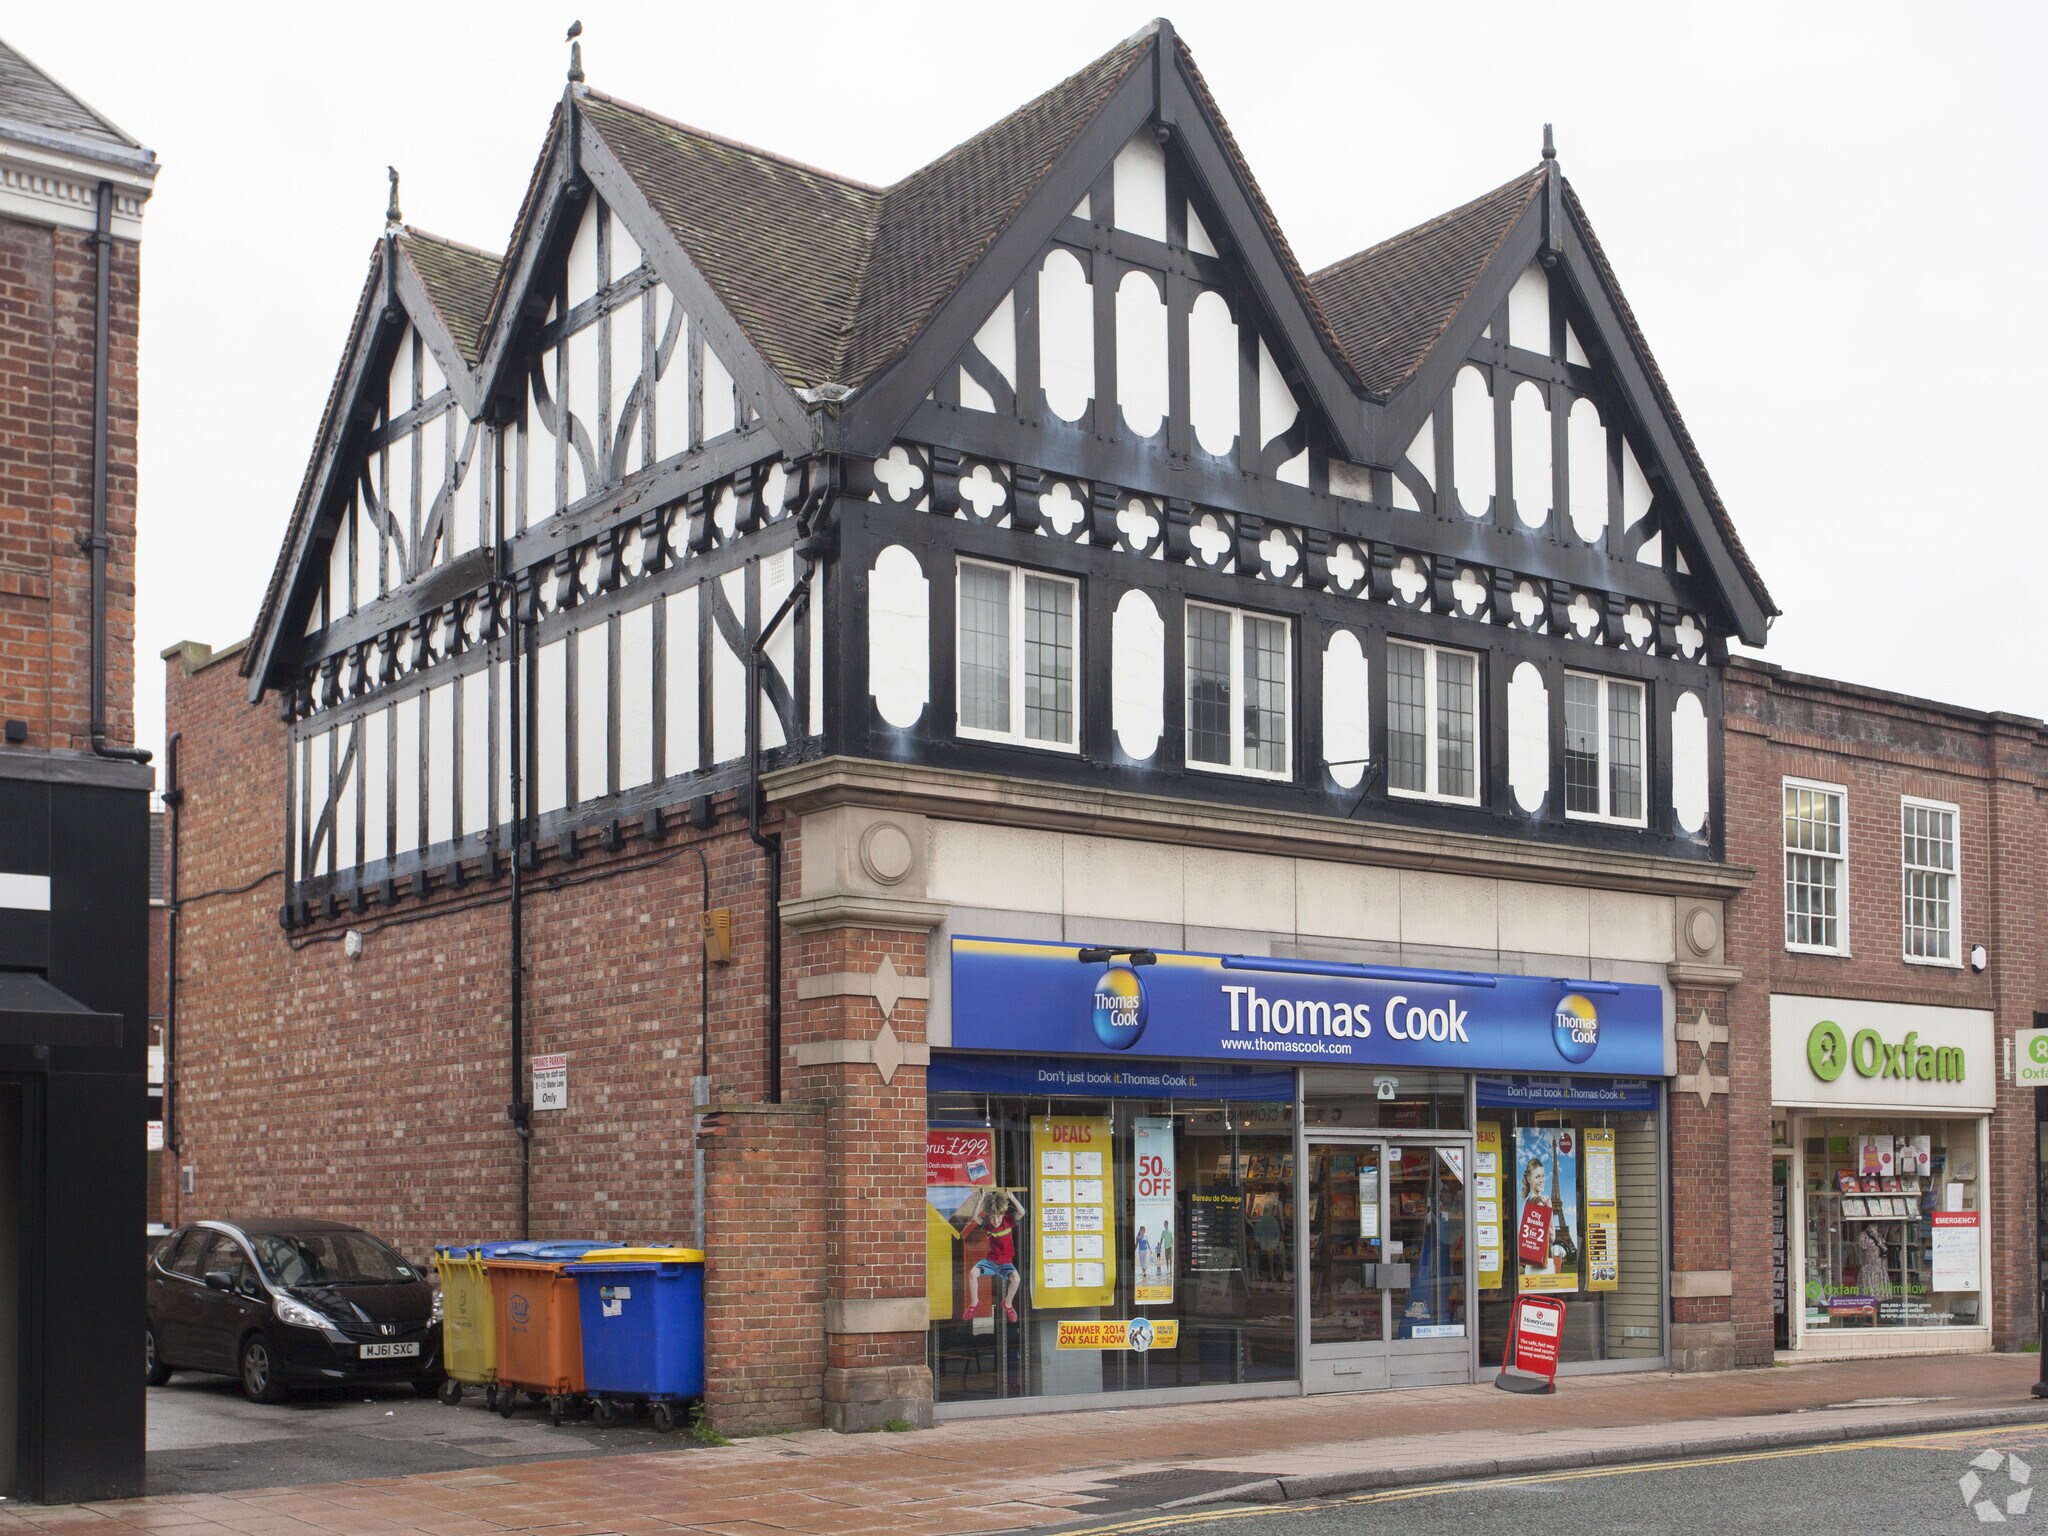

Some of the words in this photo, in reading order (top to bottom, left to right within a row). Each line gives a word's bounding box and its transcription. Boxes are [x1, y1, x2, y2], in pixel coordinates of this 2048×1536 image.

[1094, 993, 1139, 1010] Thomas
[1110, 1009, 1138, 1026] Cook
[1222, 985, 1371, 1038] Thomas
[1384, 996, 1469, 1043] Cook
[1556, 1013, 1597, 1030] Thomas
[1571, 1029, 1596, 1044] Cook
[1221, 1036, 1352, 1054] www.thomascook.com
[534, 1057, 548, 1068] PRIVATE
[549, 1055, 566, 1066] PARKING
[1852, 1028, 1966, 1082] Oxfam
[534, 1072, 546, 1081] Parking
[1038, 1069, 1065, 1082] Don't
[1066, 1072, 1085, 1085] just
[1087, 1072, 1112, 1084] book
[1122, 1073, 1160, 1085] Thomas
[1162, 1074, 1187, 1086] Cook
[1189, 1076, 1197, 1087] it.
[542, 1092, 557, 1104] Only
[1507, 1086, 1527, 1097] Don't
[1528, 1089, 1542, 1099] just
[1544, 1088, 1562, 1098] book
[1570, 1089, 1598, 1099] Thomas
[1600, 1090, 1618, 1099] Cook
[1052, 1124, 1092, 1143] DEALS
[1586, 1133, 1613, 1141] FLIGHS
[946, 1137, 988, 1156] £299
[1138, 1155, 1172, 1177] 50%
[1138, 1178, 1172, 1196] OFF
[1221, 1195, 1242, 1204] Change
[1527, 1216, 1544, 1227] Breaks
[1531, 1210, 1542, 1220] City
[1522, 1224, 1529, 1238] 3
[1537, 1228, 1544, 1242] 2
[1524, 1278, 1530, 1288] 3
[1823, 1283, 1859, 1295] Oxfam
[1876, 1283, 1927, 1295] Wilmslow
[1137, 1290, 1142, 1298] 3
[1524, 1317, 1555, 1327] MoneyGram
[1060, 1326, 1100, 1334] SUMMER
[1103, 1325, 1125, 1334] 2014
[1060, 1336, 1075, 1344] ON
[1078, 1336, 1099, 1344] SALE
[1101, 1335, 1125, 1344] NOW
[366, 1345, 390, 1356] MJ61
[393, 1344, 413, 1355] SXC
